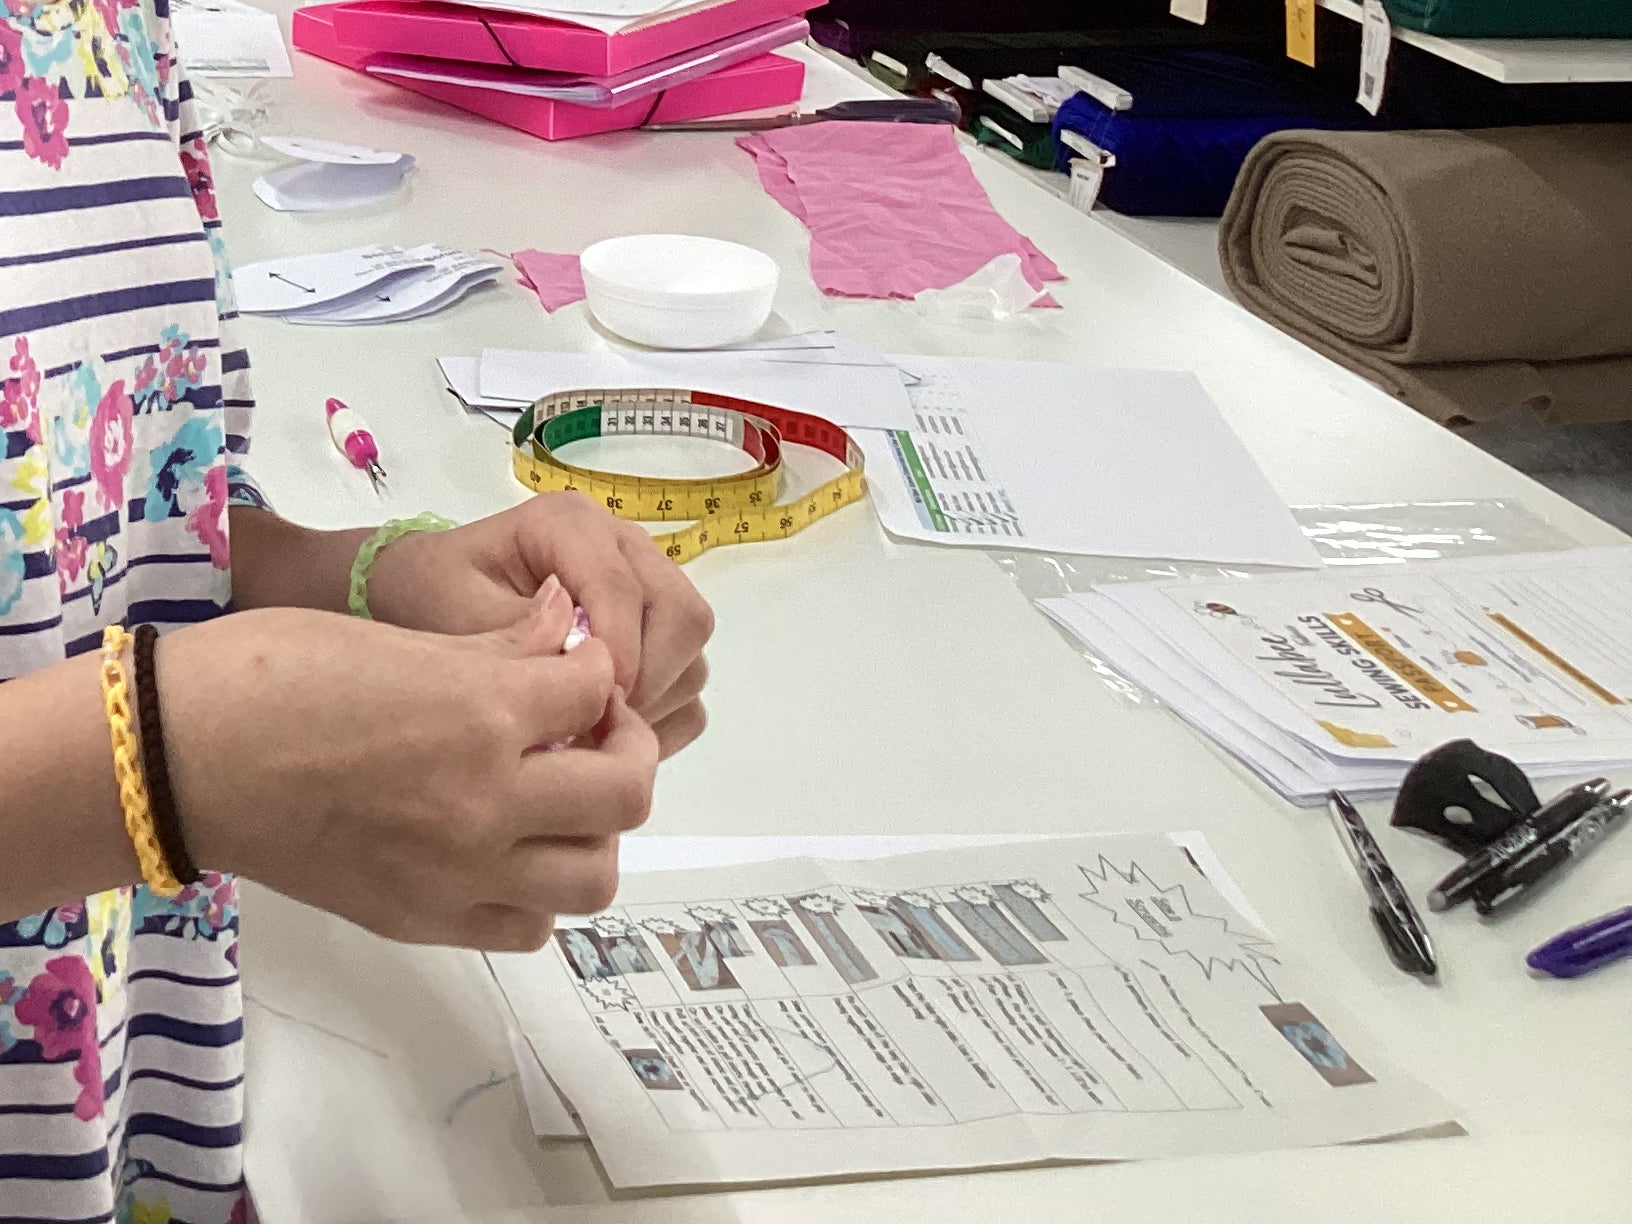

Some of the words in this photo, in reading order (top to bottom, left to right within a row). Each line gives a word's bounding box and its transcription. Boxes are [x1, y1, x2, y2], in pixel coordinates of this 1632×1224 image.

[606, 496, 624, 510] 38
[656, 499, 673, 511] 37
[734, 522, 750, 534] 57
[666, 544, 681, 557] 59
[1297, 614, 1361, 656] SKILLS
[1353, 630, 1444, 695] PASSPORT
[1351, 658, 1431, 711] SEWING
